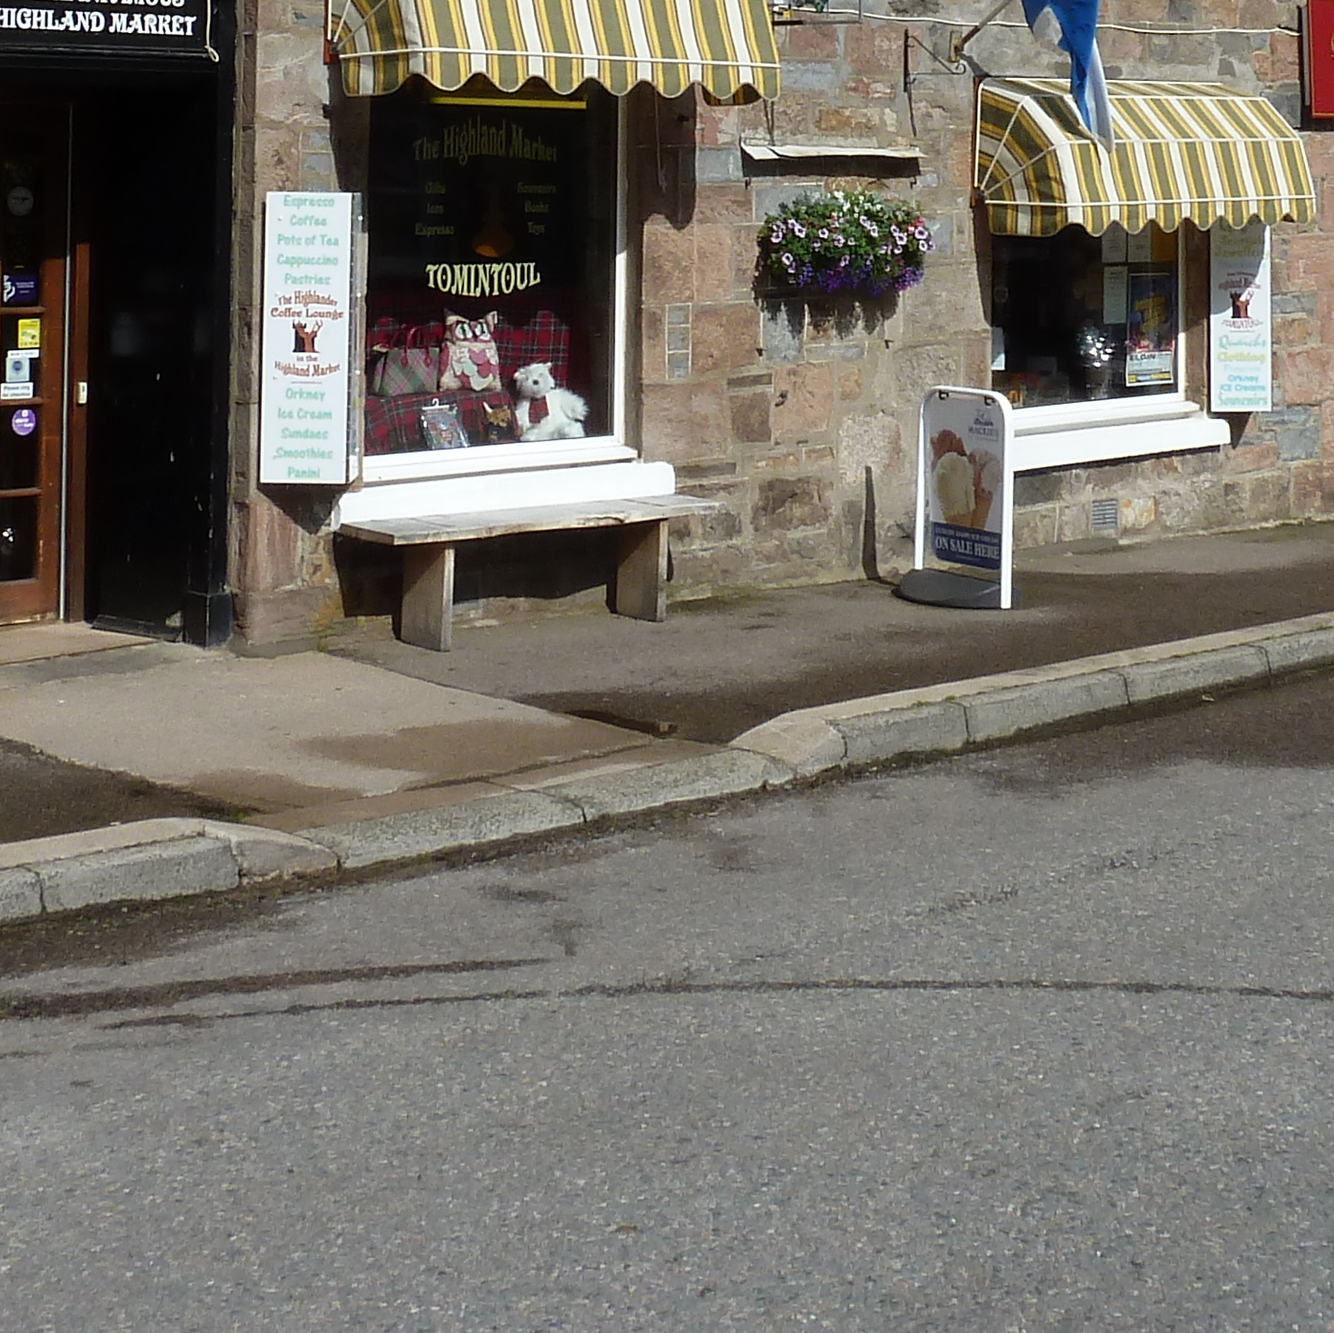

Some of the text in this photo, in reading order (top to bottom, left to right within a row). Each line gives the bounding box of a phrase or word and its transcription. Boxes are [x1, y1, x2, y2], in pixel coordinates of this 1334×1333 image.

[108, 12, 197, 35] MARKET
[412, 113, 558, 166] The Highland Market
[284, 195, 335, 210] Espresso
[289, 214, 328, 226] Coffee
[277, 233, 340, 246] Pots of Tea
[277, 253, 339, 268] Cappuccino
[284, 272, 331, 286] Pastries
[425, 262, 541, 297] TOMINTOUL
[278, 289, 338, 307] The Highlander
[270, 307, 344, 320] Coffee Lounge
[307, 355, 318, 363] the
[274, 361, 340, 377] Highland Market
[285, 388, 326, 401] Orkney
[278, 408, 333, 420] Ice Cream
[282, 428, 328, 440] Sundaes
[277, 447, 333, 460] Smoothies
[288, 467, 321, 479] Panini
[936, 536, 1000, 559] ON SALE HERE
